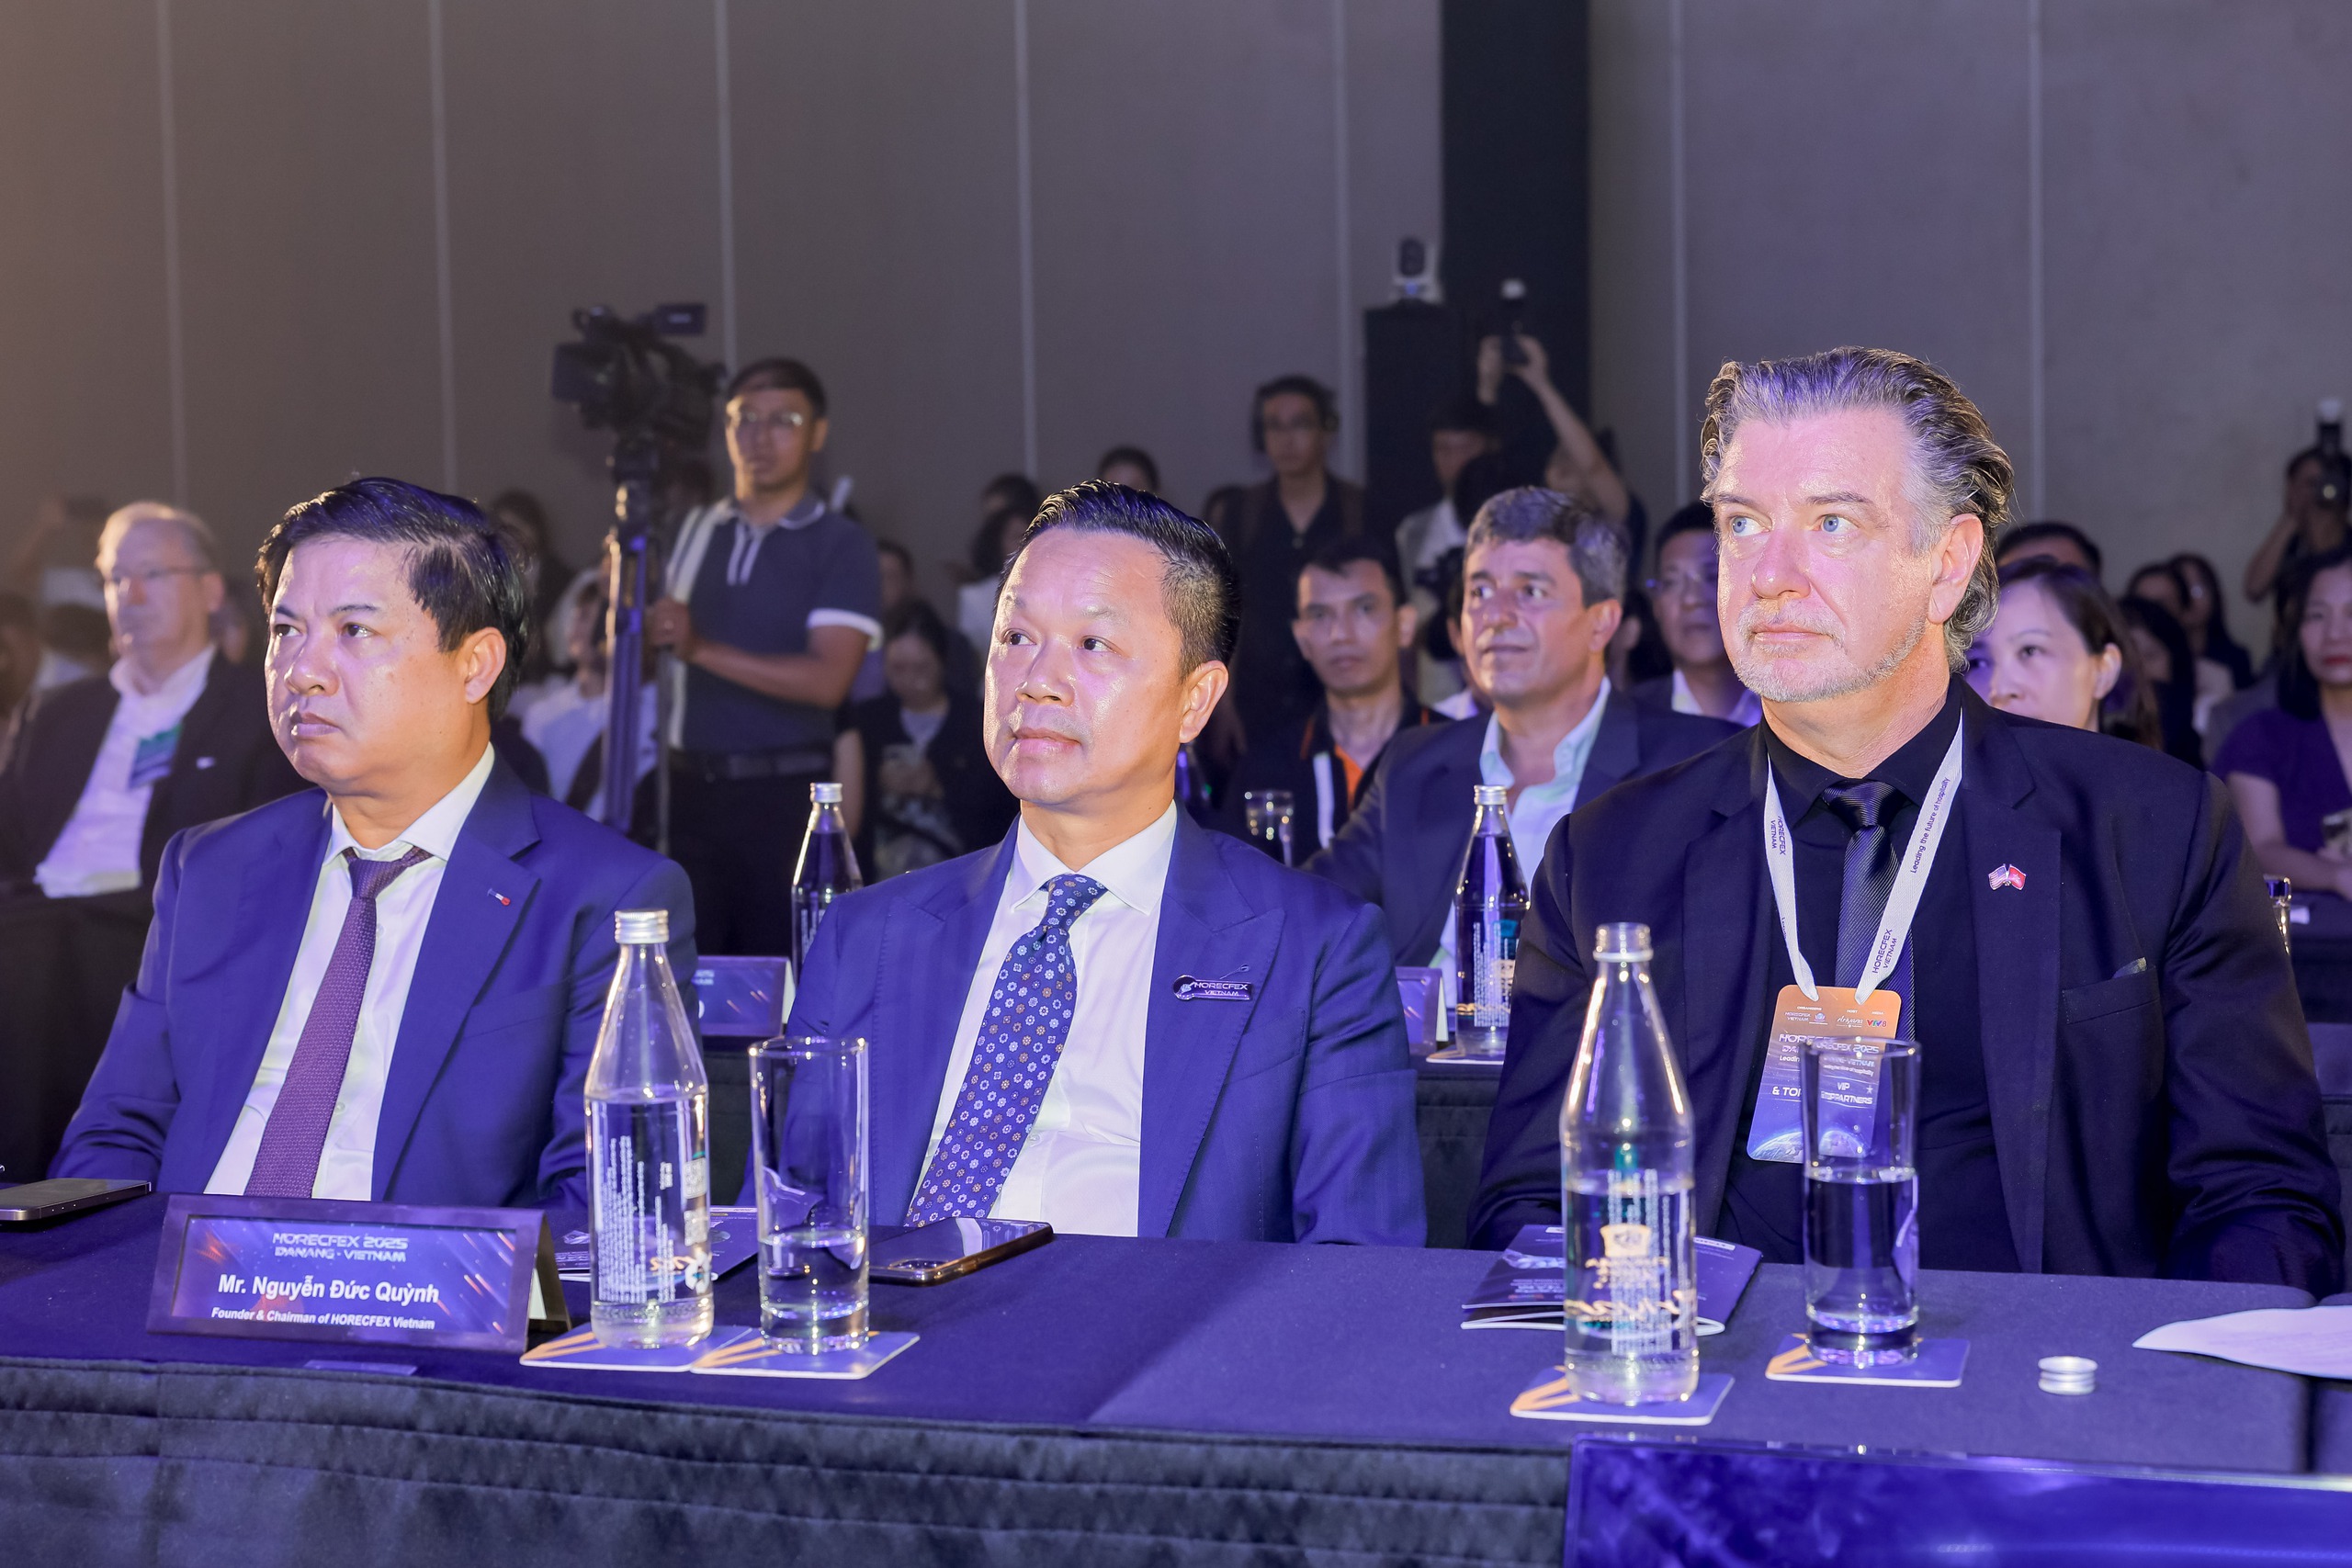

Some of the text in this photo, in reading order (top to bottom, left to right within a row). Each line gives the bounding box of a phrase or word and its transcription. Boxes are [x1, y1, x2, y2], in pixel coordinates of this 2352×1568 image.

[1910, 845, 1926, 874] Leading
[1920, 832, 1929, 844] the
[1925, 812, 1937, 832] future
[1935, 776, 1951, 805] hospitality
[1871, 929, 1893, 974] HORECFEX
[1883, 938, 1897, 969] VIETNAM
[1853, 1044, 1880, 1054] 2025
[1771, 1086, 1781, 1095] &
[1838, 1082, 1850, 1091] VIP
[272, 1233, 409, 1250] HORECFEX 2025
[275, 1247, 335, 1260] DANANG
[344, 1248, 407, 1263] VIETNAM
[218, 1273, 440, 1307] Mr. Nguyễn Đức Quỳnh
[211, 1306, 435, 1330] Founder & Chairman of HORECFEX Vietnam
